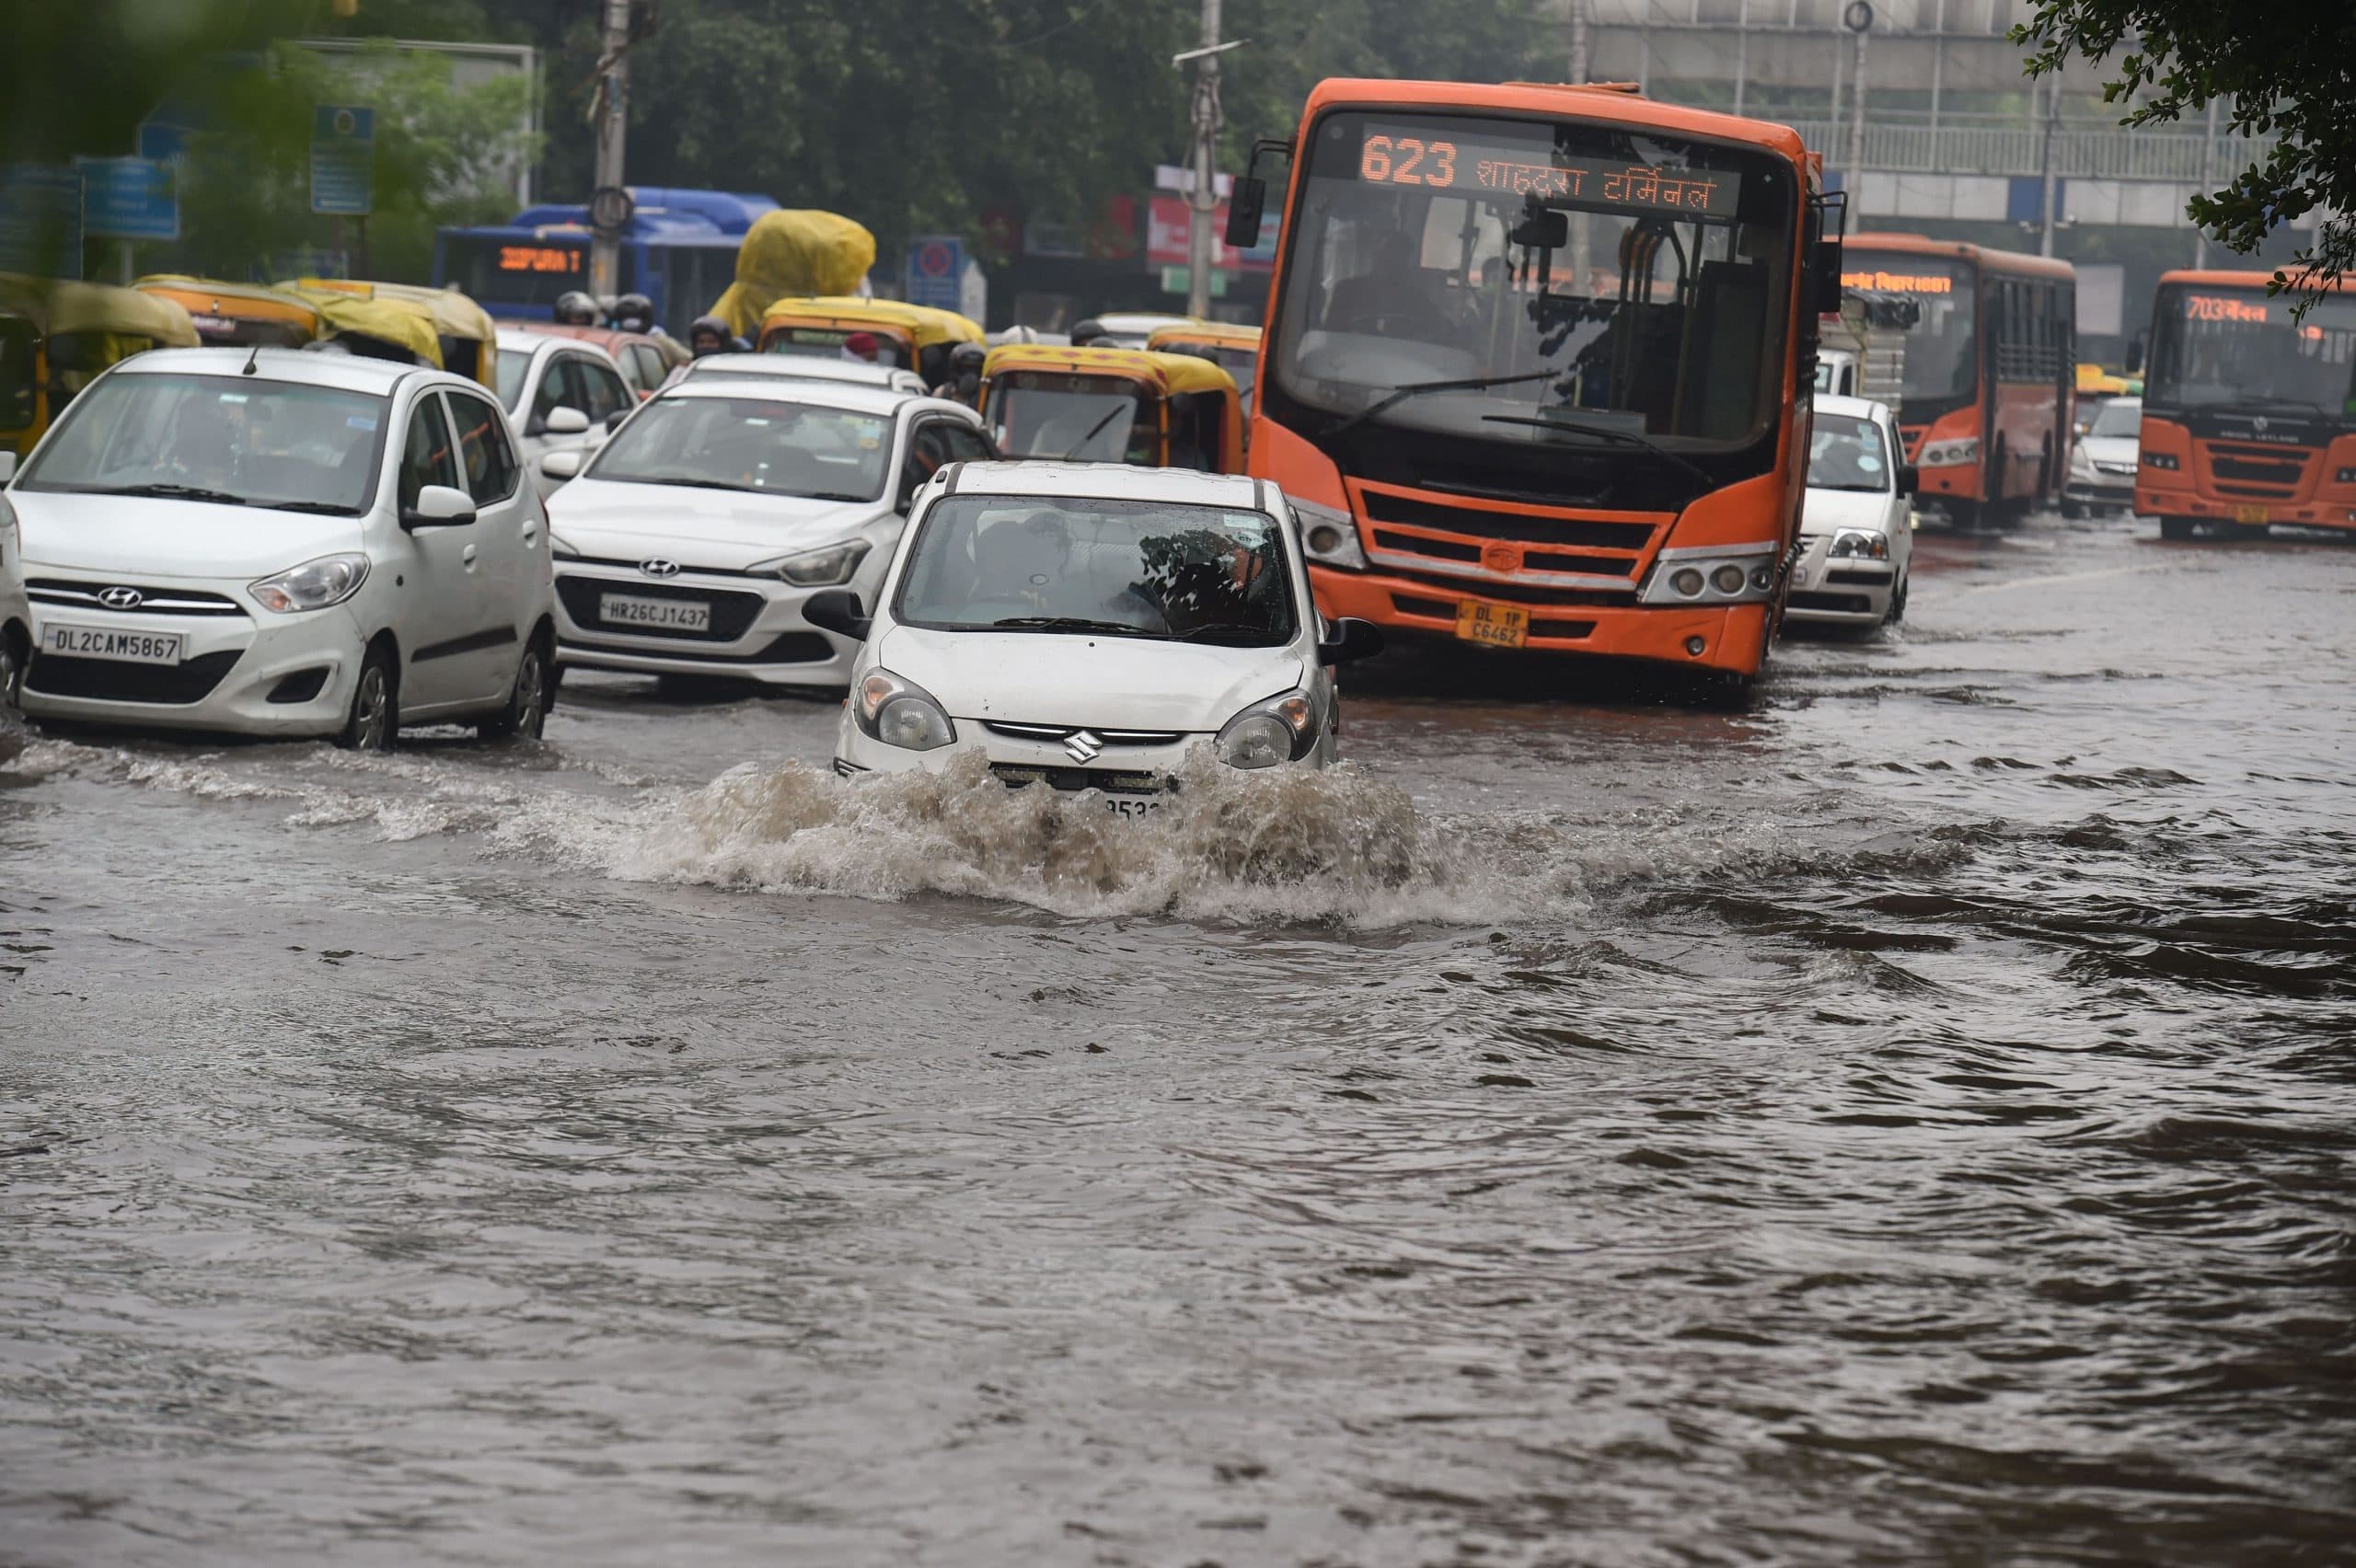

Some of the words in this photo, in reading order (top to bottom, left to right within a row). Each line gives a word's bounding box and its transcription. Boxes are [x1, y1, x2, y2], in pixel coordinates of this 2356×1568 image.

[1361, 135, 1457, 188] 623
[2188, 295, 2224, 322] 703
[610, 601, 708, 627] HR26CJ1437
[55, 629, 178, 660] DL2CAM5867
[1106, 799, 1160, 821] 953
